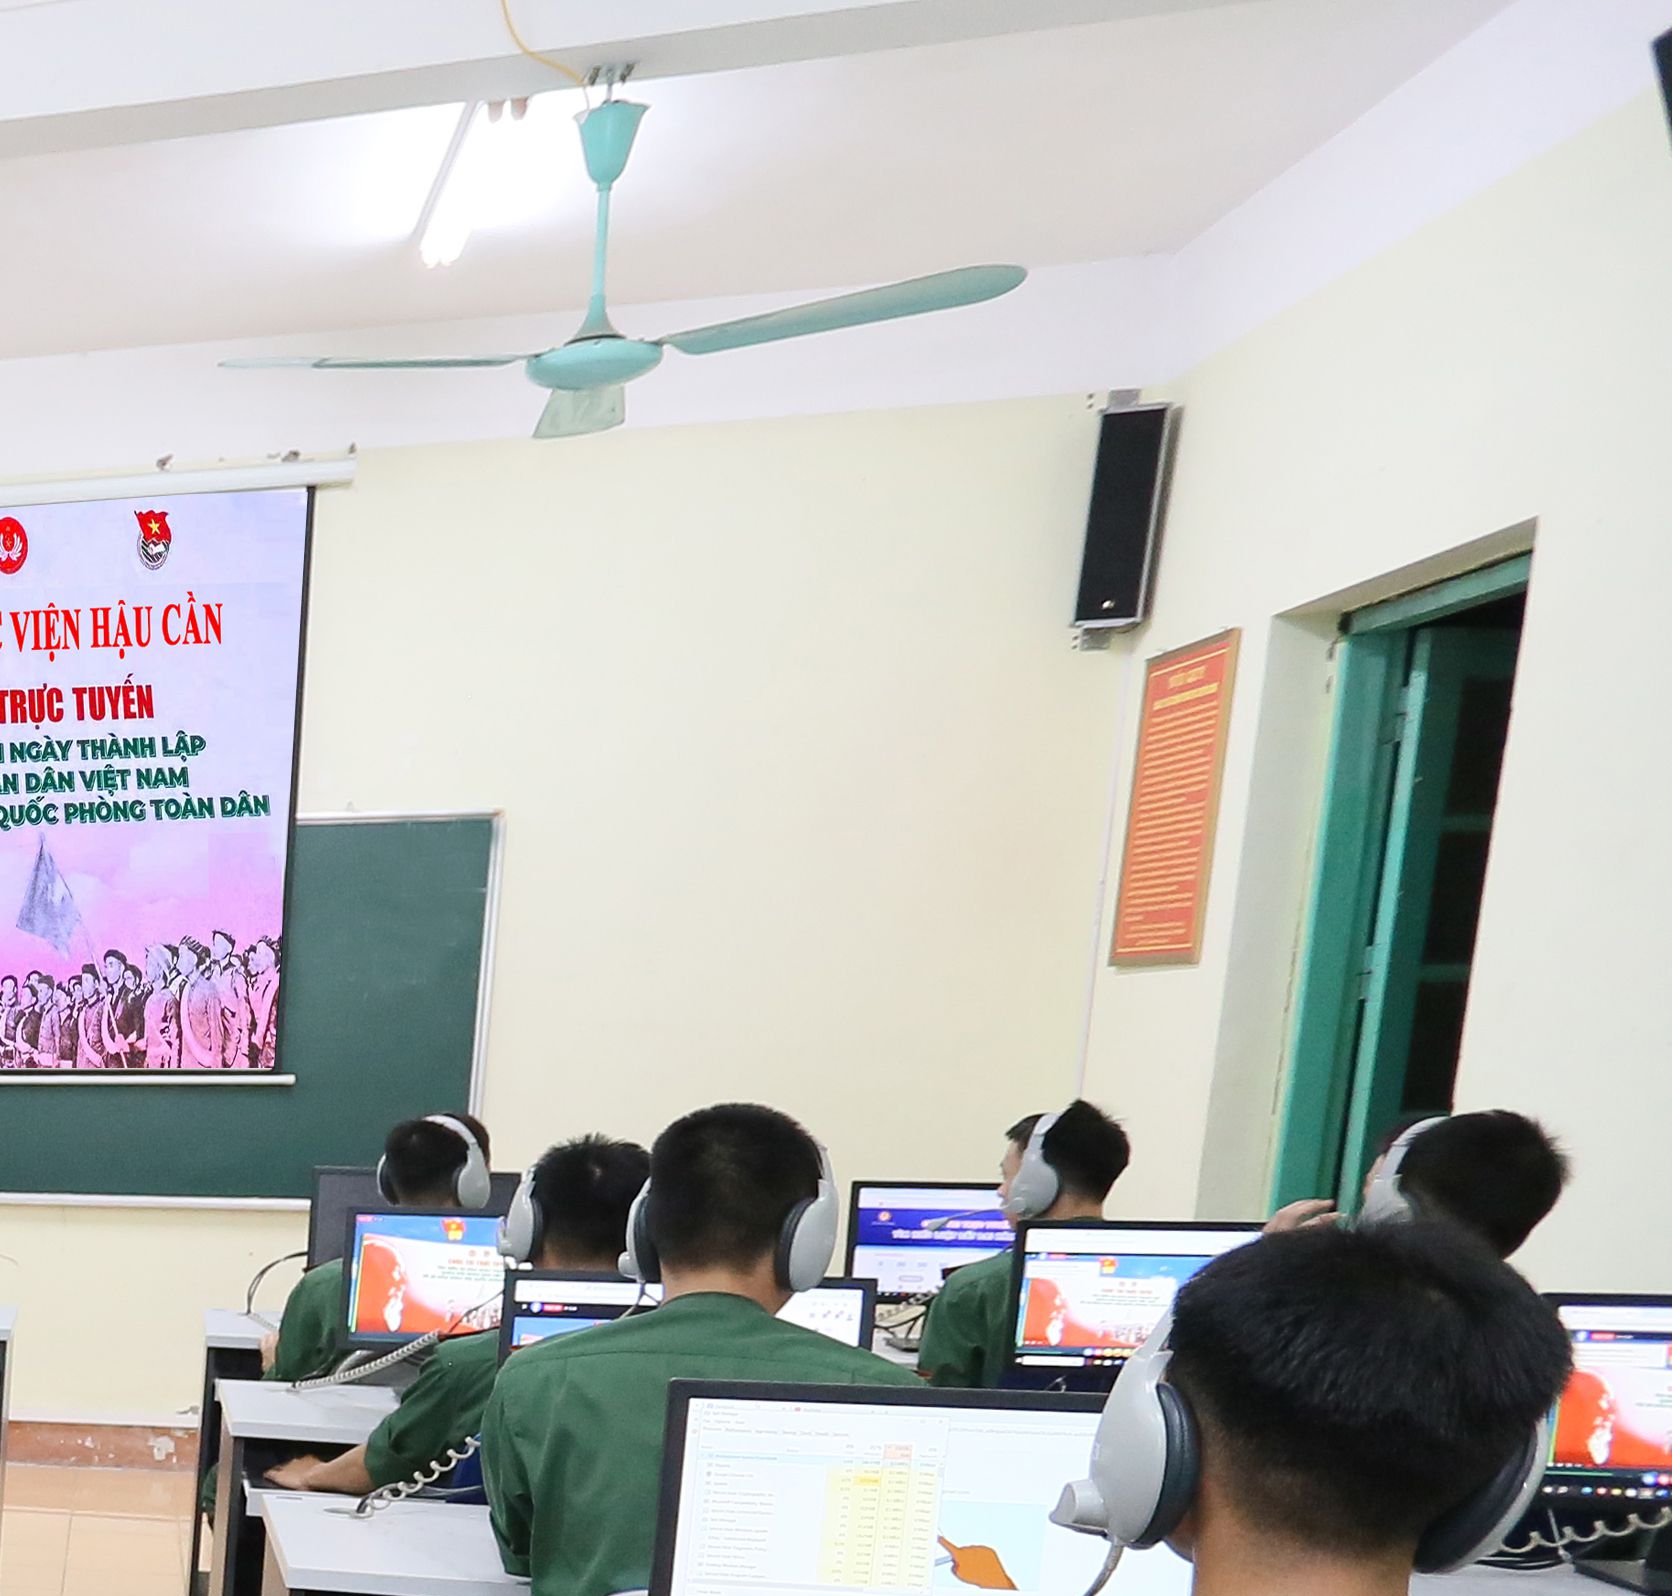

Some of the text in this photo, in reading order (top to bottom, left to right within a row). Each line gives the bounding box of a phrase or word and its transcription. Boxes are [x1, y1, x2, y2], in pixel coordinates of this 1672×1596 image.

[9, 602, 81, 662] VIỆN
[90, 600, 153, 659] HẬU
[161, 591, 223, 646] CẦN
[72, 673, 154, 721] TUYẾN
[10, 738, 74, 763] NGÀY
[77, 733, 159, 760] THÀNH
[162, 730, 206, 761] LẬP
[25, 767, 76, 793] DÂN
[79, 763, 131, 795] VIỆT
[136, 766, 188, 789] NAM
[64, 800, 147, 825] PHÒNG
[149, 793, 216, 820] TOÀN
[220, 790, 270, 818] DÂN
